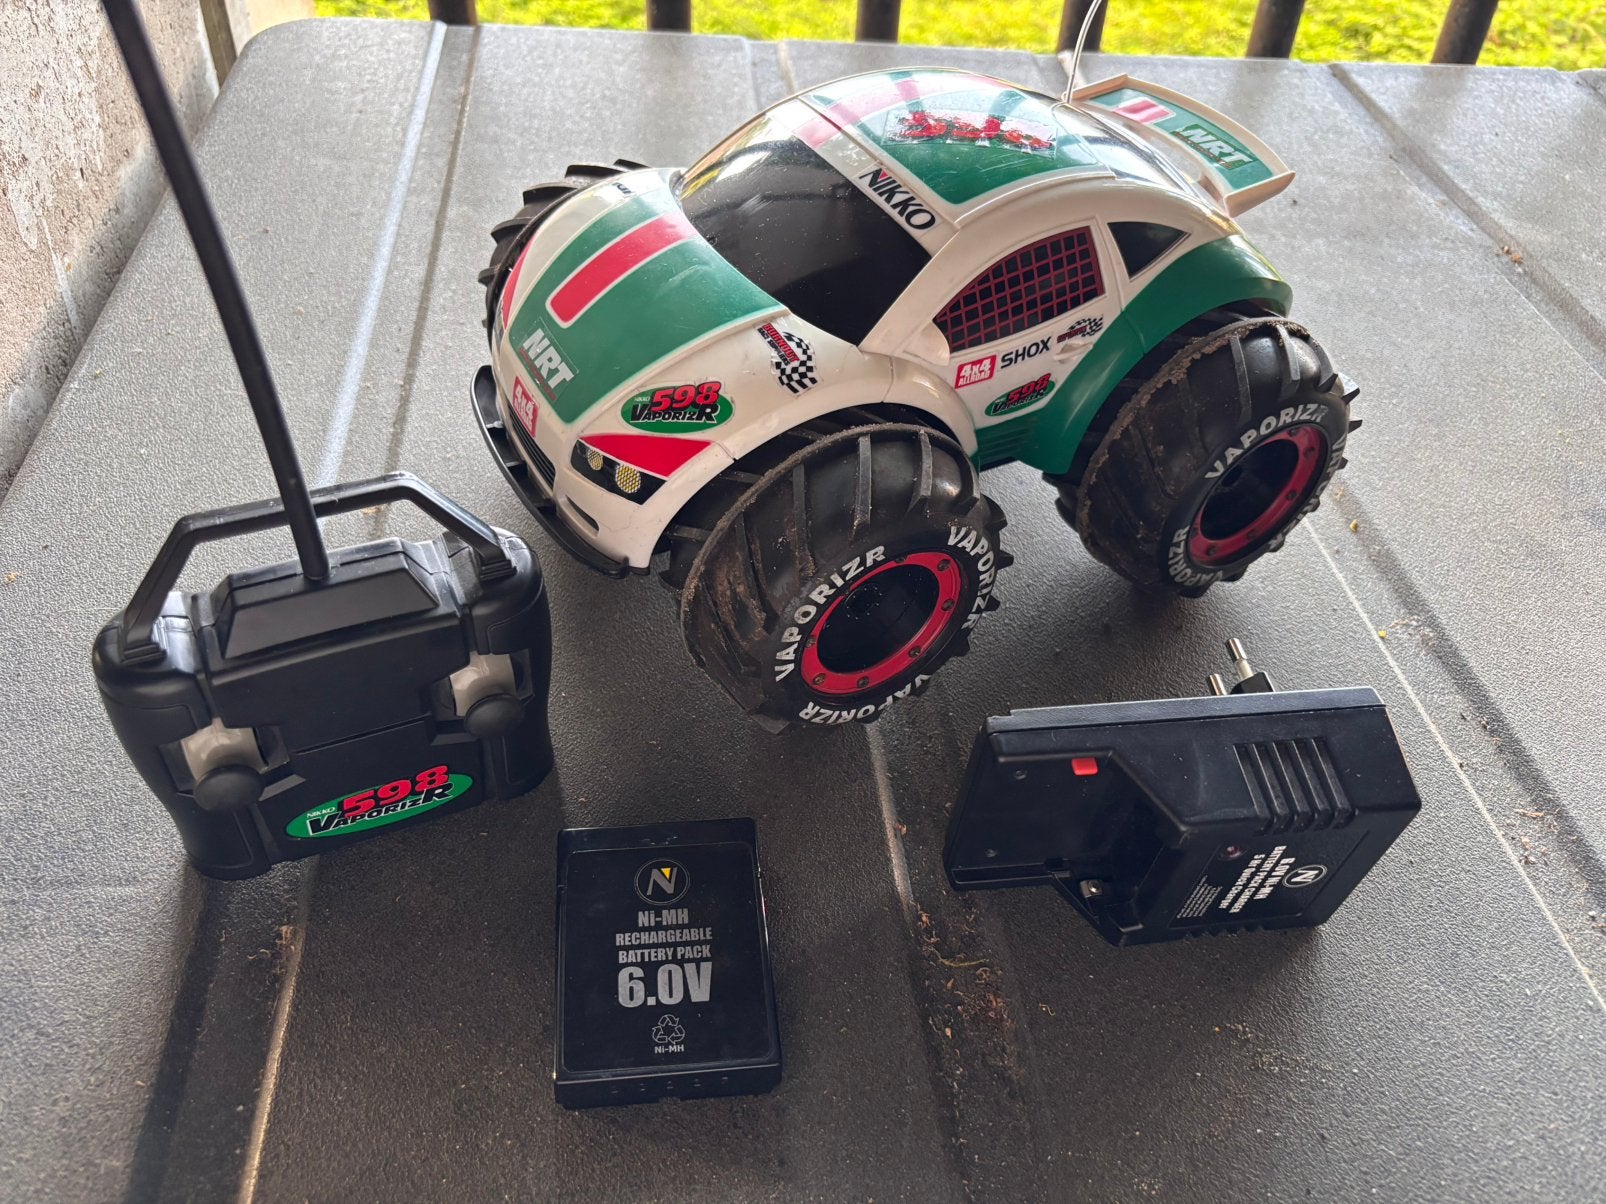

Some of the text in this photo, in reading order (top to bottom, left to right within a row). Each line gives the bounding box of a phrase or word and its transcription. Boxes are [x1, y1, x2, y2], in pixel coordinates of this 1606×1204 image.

[1180, 128, 1254, 163] NRT
[858, 167, 936, 230] NIKKO
[522, 328, 575, 389] NRT
[1001, 336, 1052, 369] SHOX
[651, 381, 721, 412] 598
[1007, 372, 1051, 405] 598
[948, 526, 997, 630] VAPORIZR
[775, 545, 886, 682] VAPORIZR
[341, 765, 449, 819] 598
[306, 806, 336, 818] NIKKO
[637, 908, 689, 927] Ni-MH
[615, 927, 713, 946] RECHARGEABLE
[618, 944, 711, 964] BATTERY PACK
[617, 961, 713, 1008] 6.0V
[654, 1044, 685, 1054] Ni-MH
